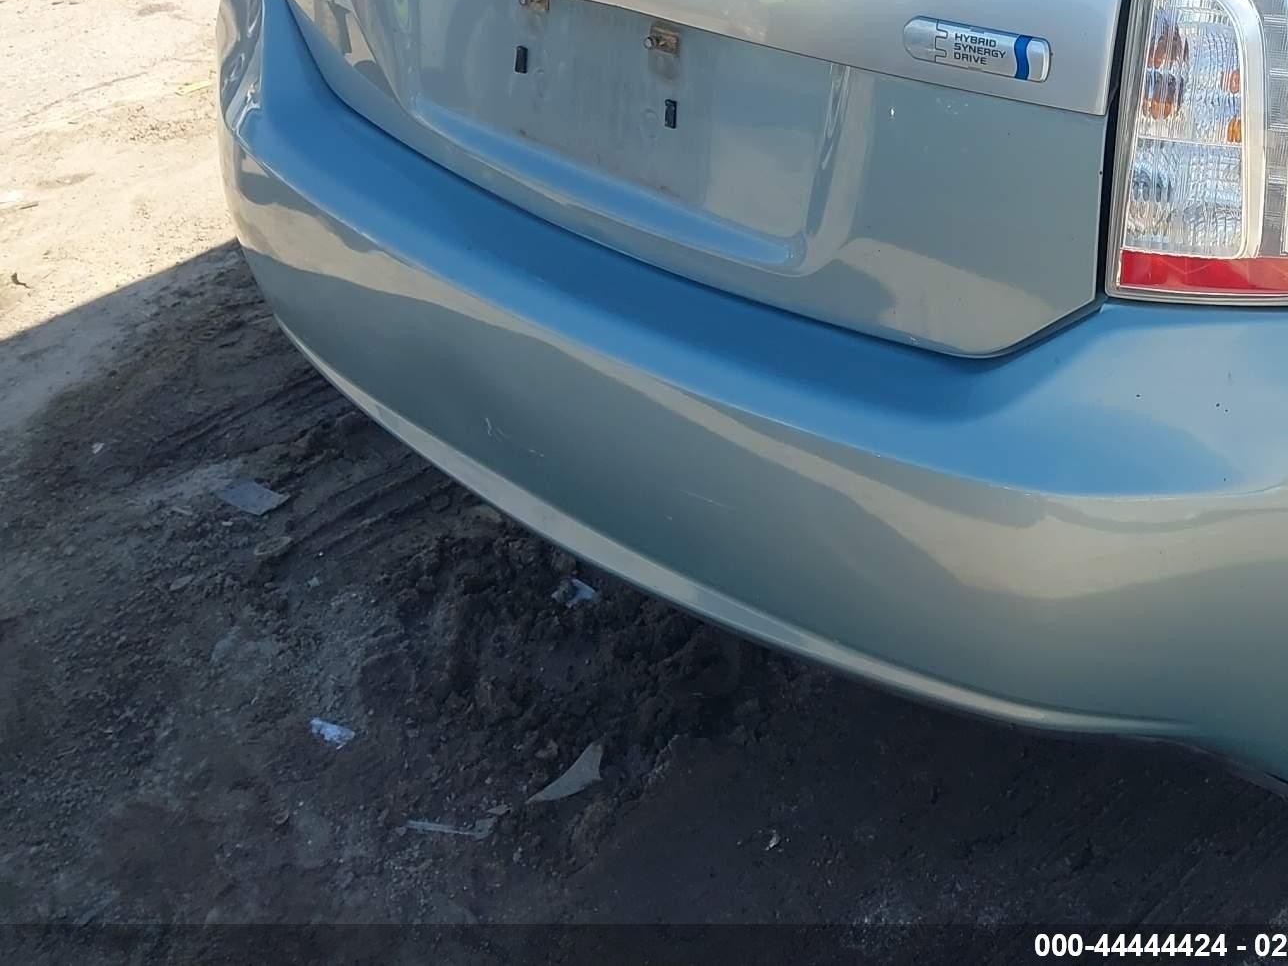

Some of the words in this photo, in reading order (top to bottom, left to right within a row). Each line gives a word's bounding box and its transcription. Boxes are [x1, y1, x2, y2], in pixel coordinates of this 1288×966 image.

[954, 32, 997, 48] HYBRID
[953, 42, 1006, 59] SYNERGY
[953, 51, 988, 65] DRIVE
